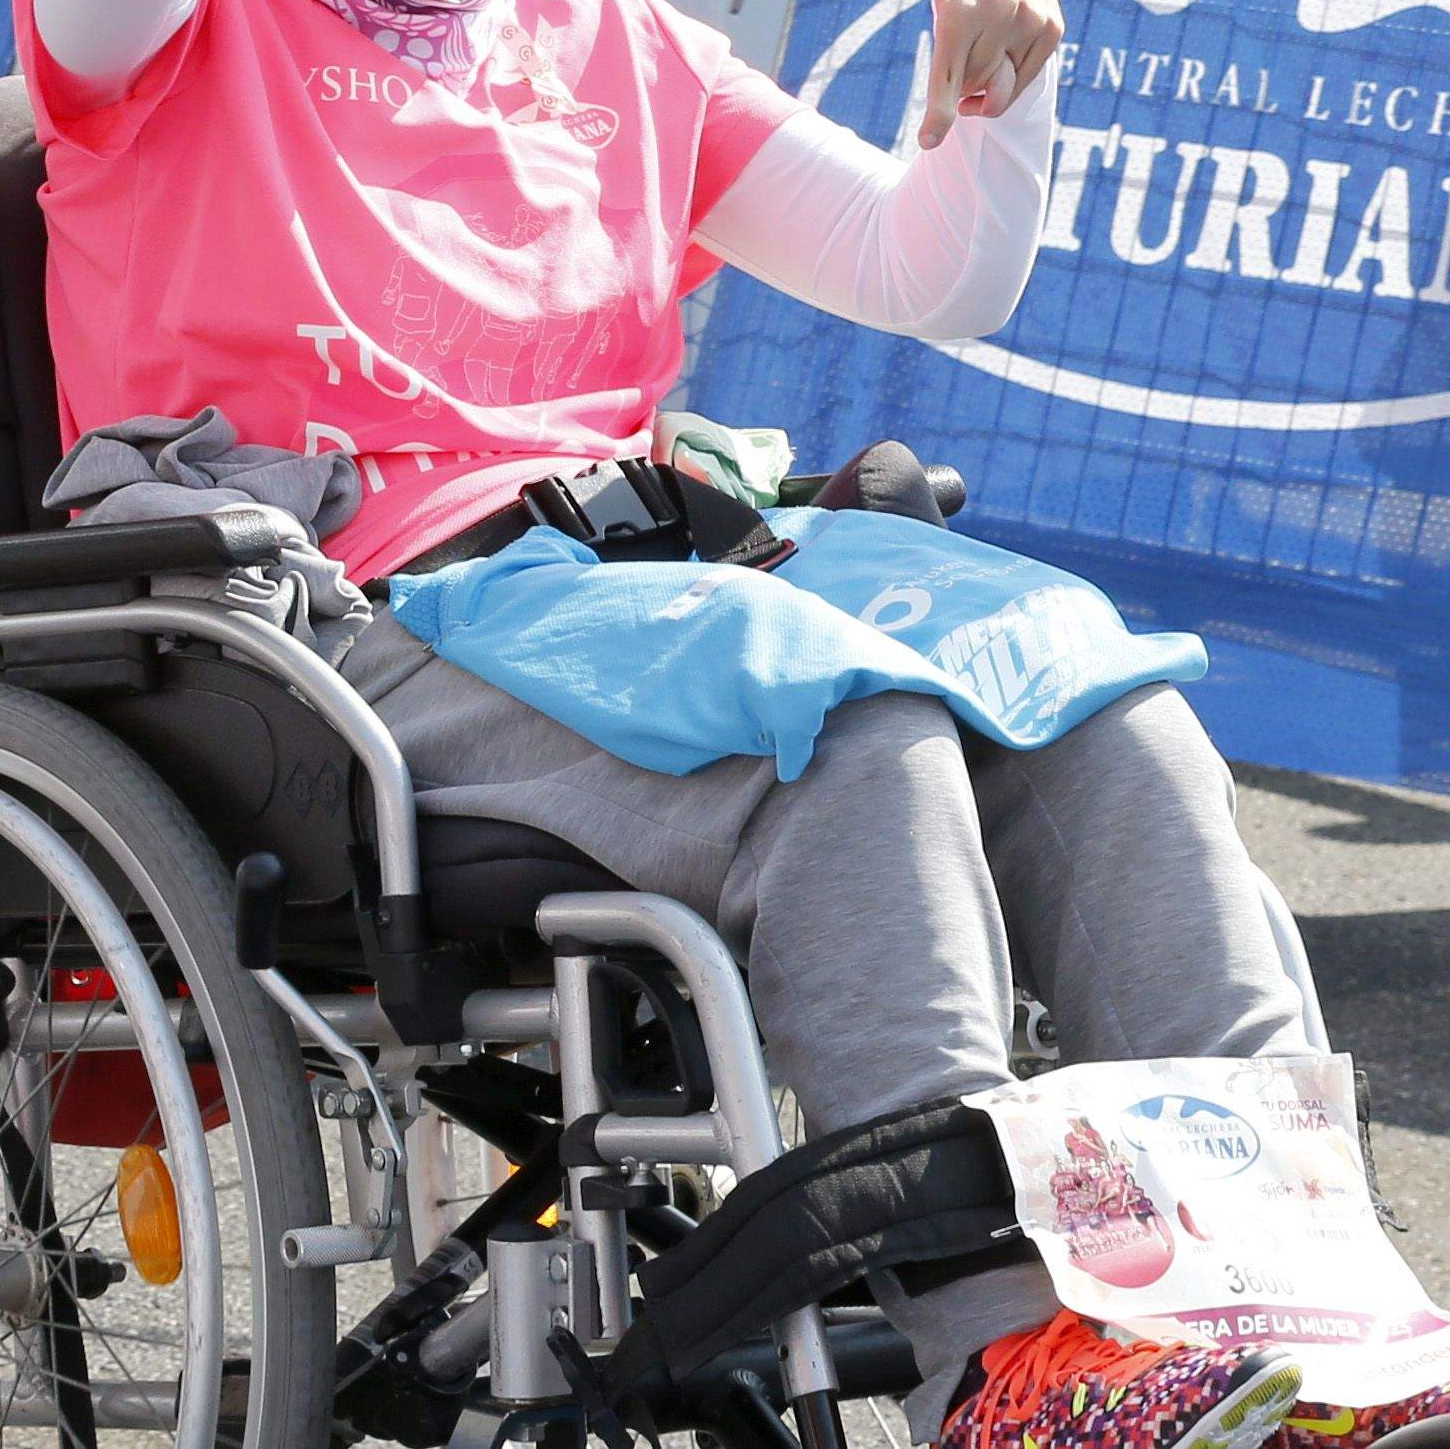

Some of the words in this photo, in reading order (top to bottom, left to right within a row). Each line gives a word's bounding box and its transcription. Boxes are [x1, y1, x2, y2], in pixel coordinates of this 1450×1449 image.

[303, 65, 413, 108] YSHO
[1055, 41, 1279, 114] ENTRAL
[1271, 1112, 1332, 1132] SUMA
[1237, 1314, 1269, 1335] DE
[1271, 1314, 1296, 1335] LA
